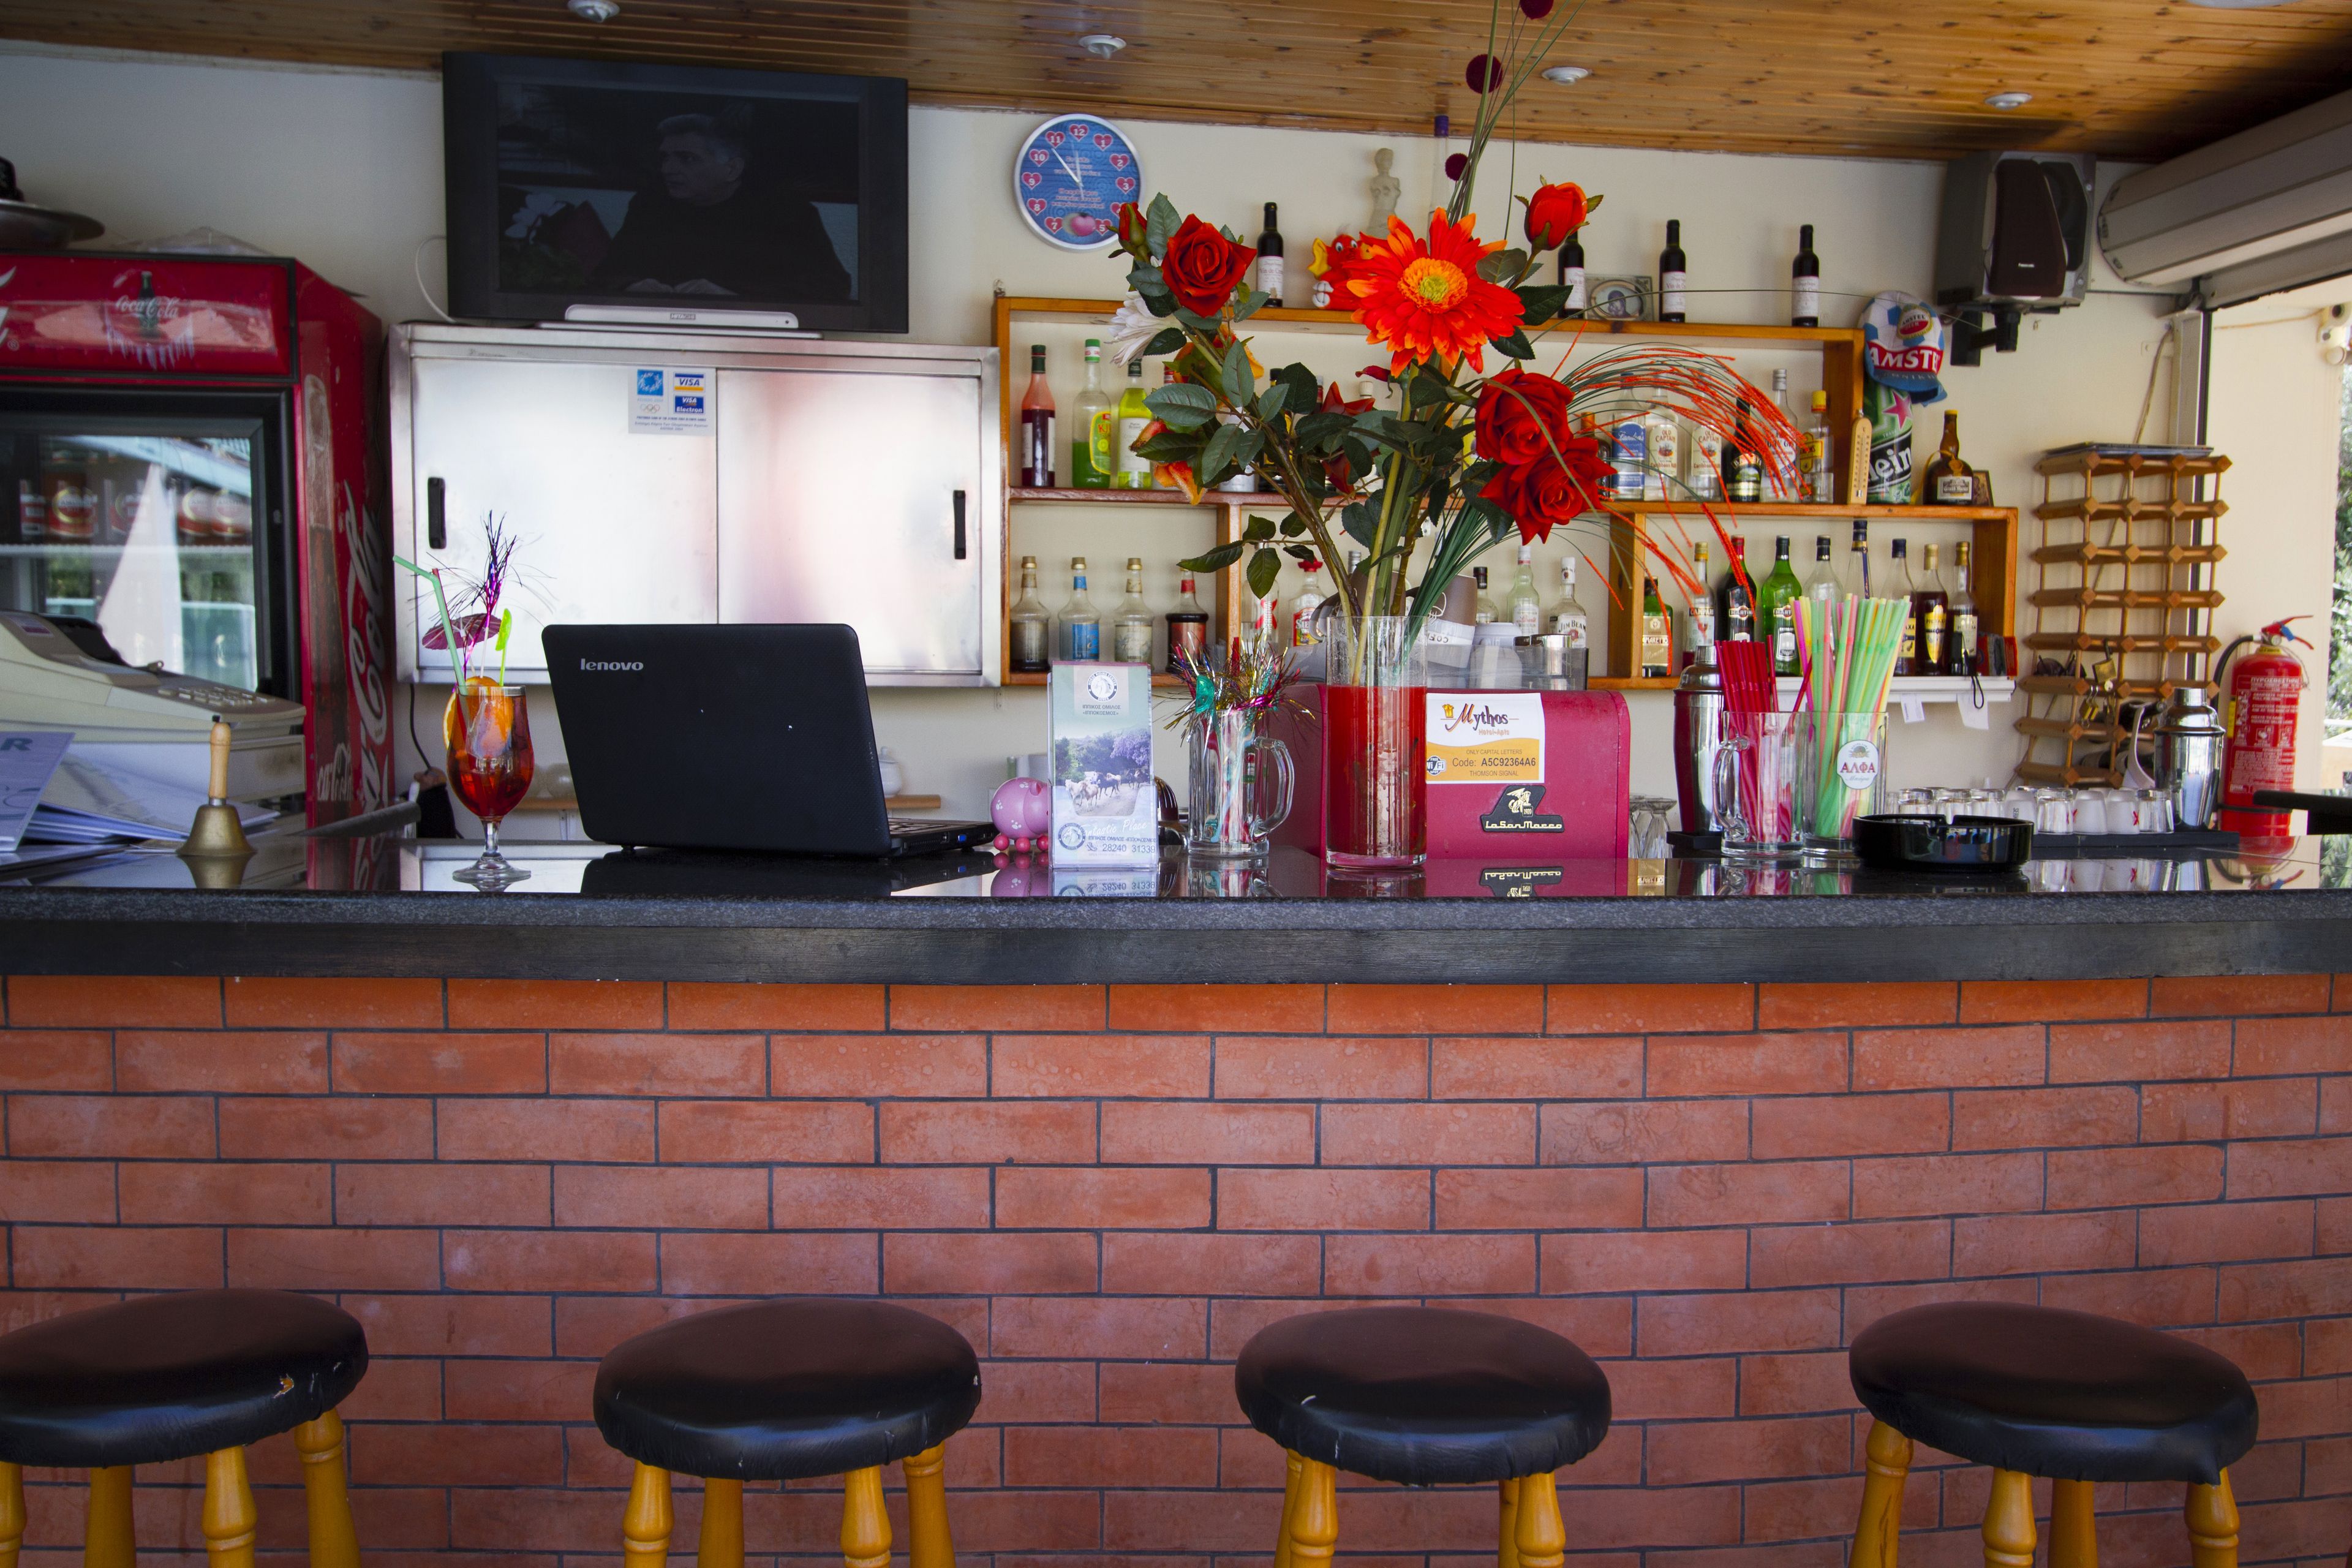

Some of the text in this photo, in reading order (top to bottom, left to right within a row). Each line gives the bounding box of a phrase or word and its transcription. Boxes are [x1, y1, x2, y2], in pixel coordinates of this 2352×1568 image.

[1902, 314, 1925, 325] AMSTEL
[1559, 622, 1570, 633] JIM
[581, 658, 644, 671] lenovo
[1445, 703, 1509, 733] Mythos
[1452, 758, 1536, 766] Code: A5C92364A6
[1839, 761, 1875, 774] ΑΛΦΑ
[1122, 819, 1147, 832] Place
[1102, 843, 1156, 853] 28240 31339
